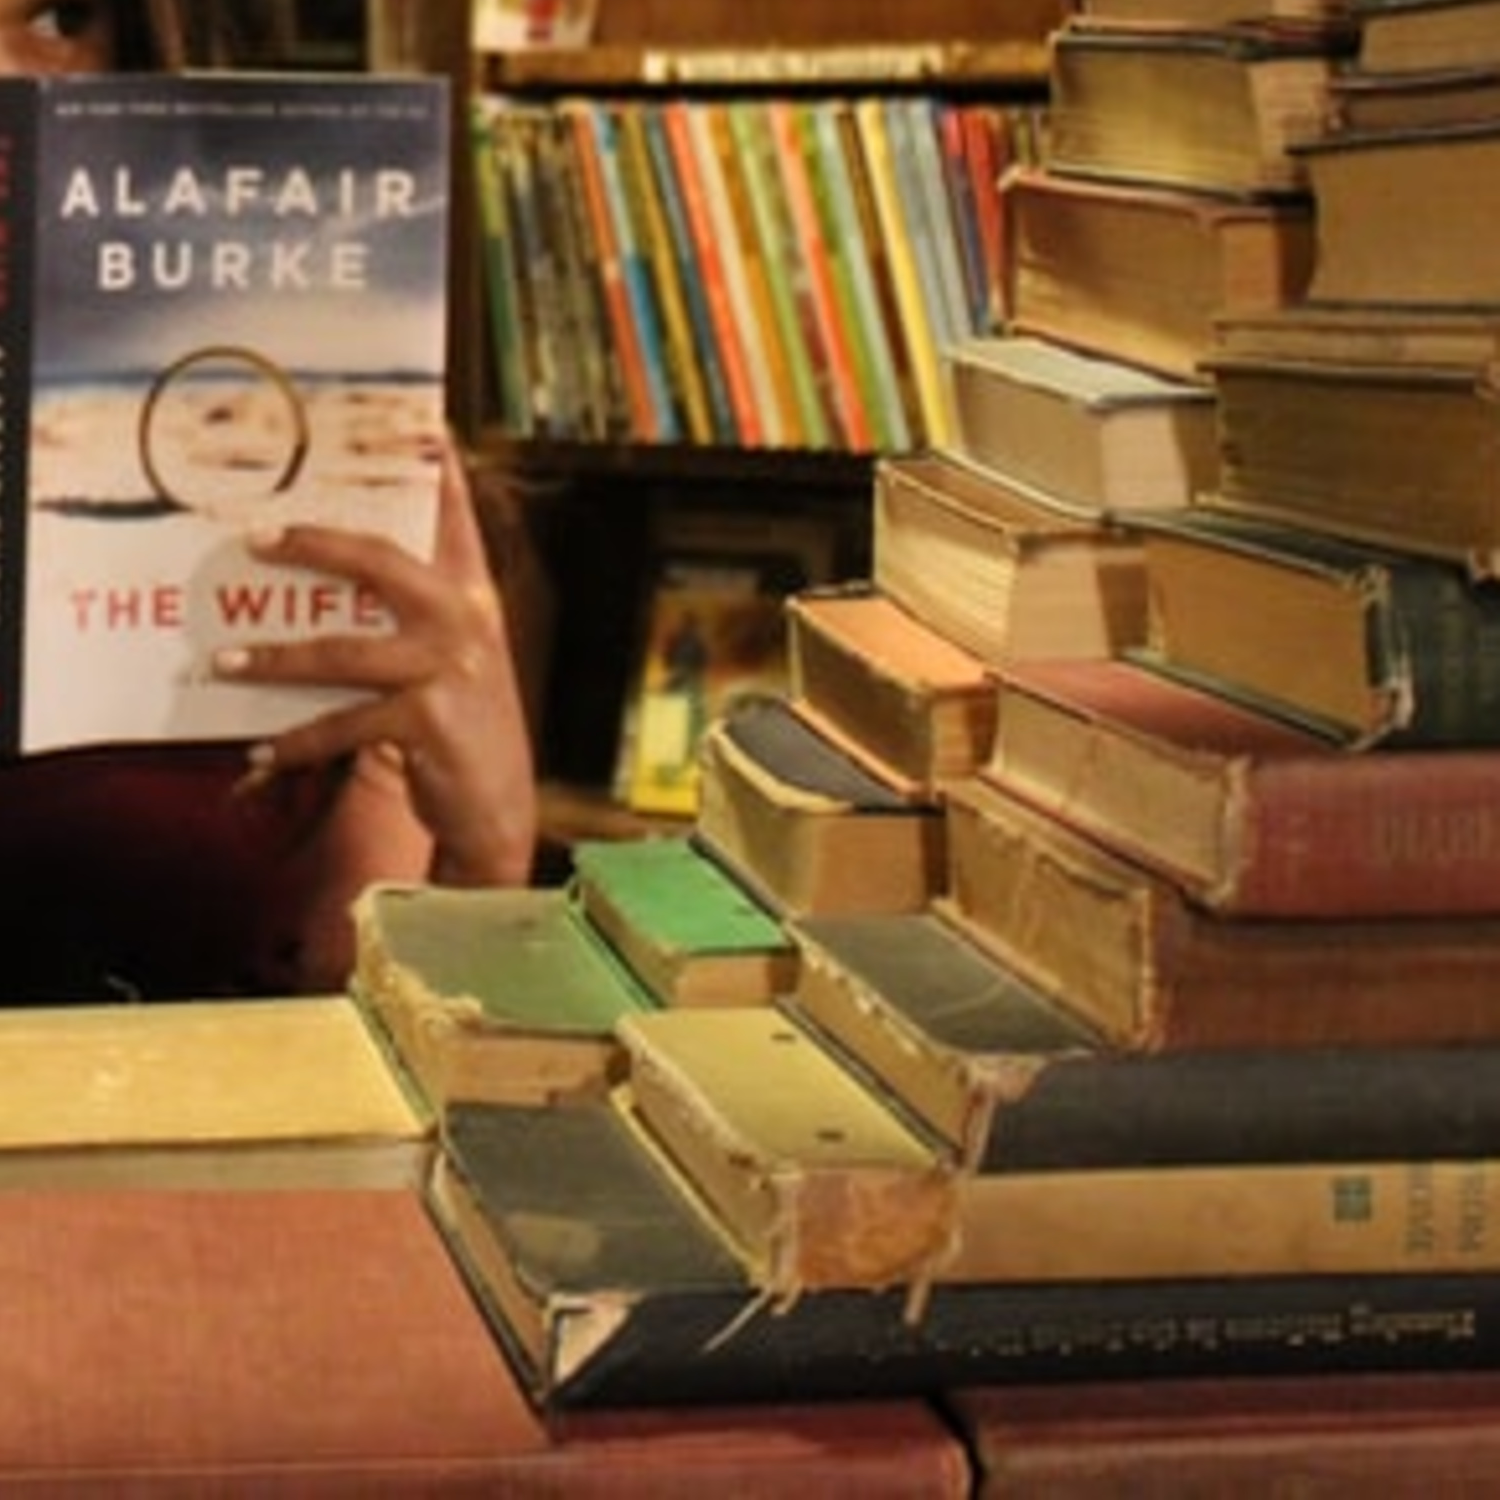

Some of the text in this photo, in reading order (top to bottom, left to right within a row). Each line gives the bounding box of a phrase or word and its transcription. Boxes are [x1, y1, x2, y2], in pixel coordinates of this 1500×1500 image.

[61, 167, 418, 219] ALAFAIR
[100, 241, 370, 291] BURKE
[70, 583, 384, 630] THE WIFE
